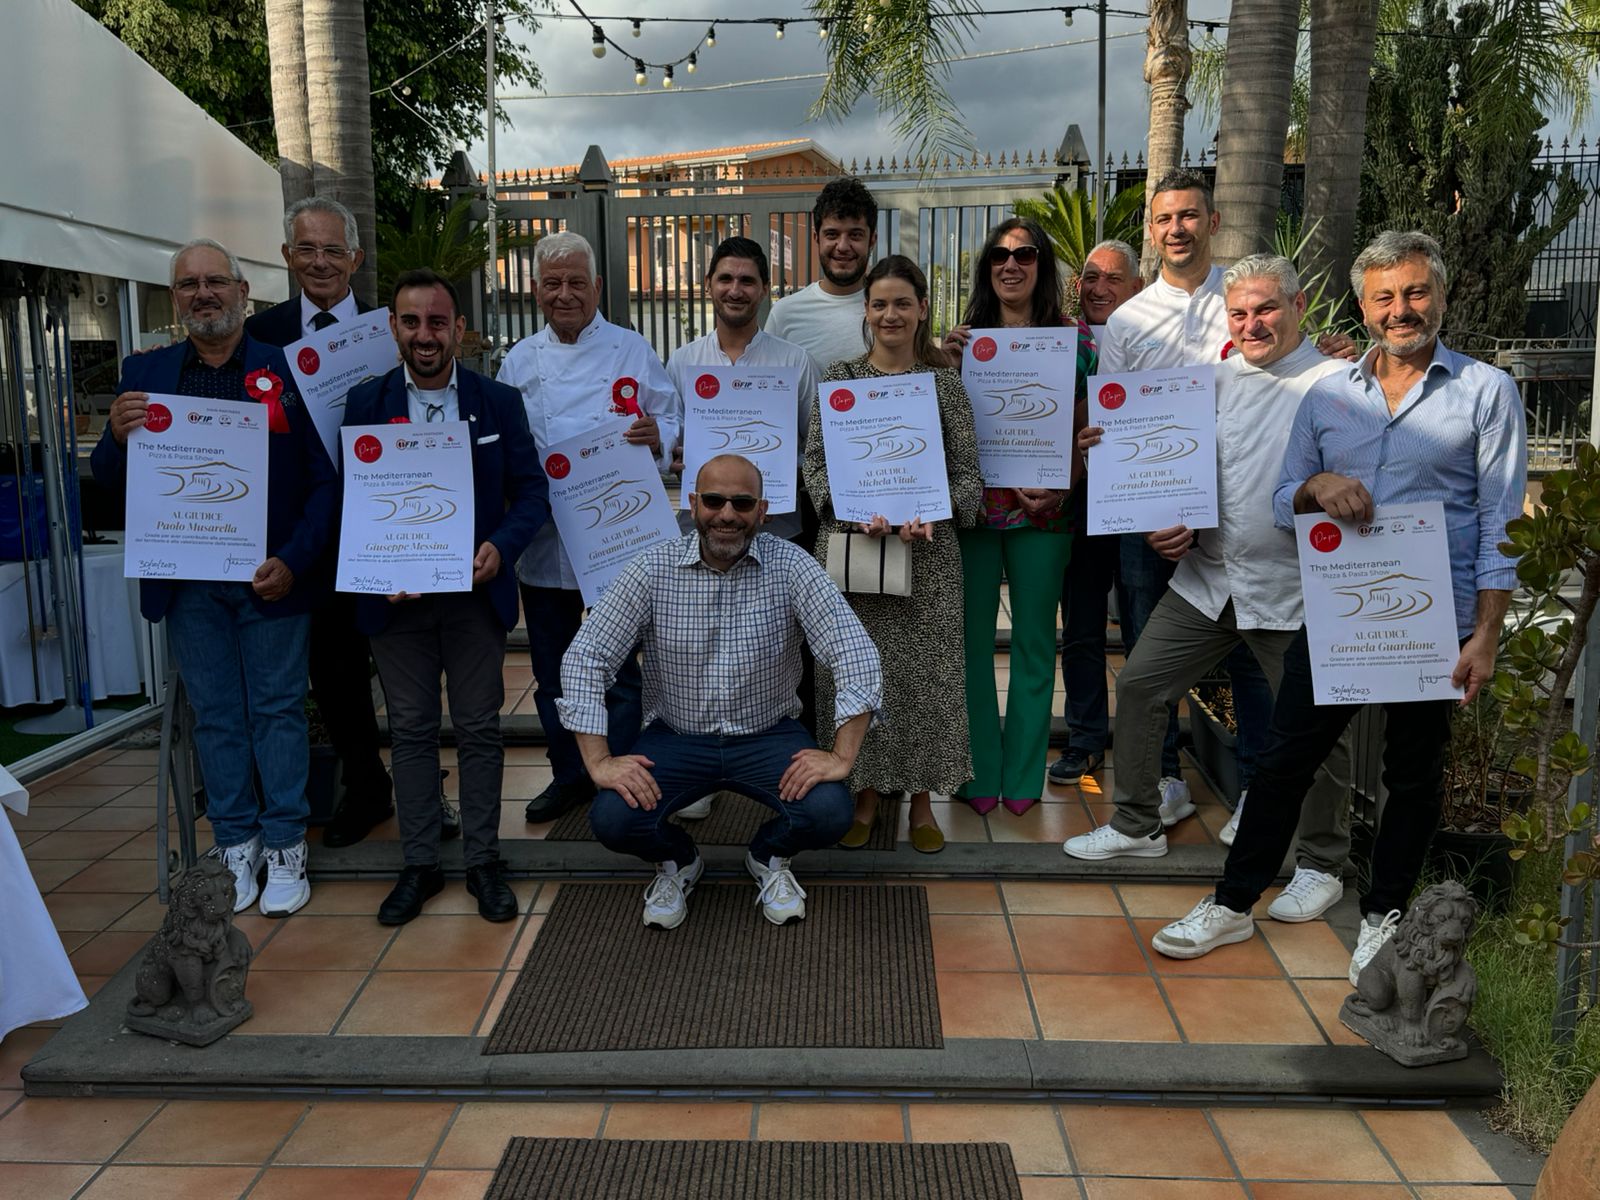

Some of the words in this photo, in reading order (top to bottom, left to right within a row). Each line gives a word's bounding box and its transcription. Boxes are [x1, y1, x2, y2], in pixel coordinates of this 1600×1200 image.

[307, 386, 319, 396] The
[845, 416, 902, 425] Mediterranean
[1114, 414, 1174, 425] Mediterranean
[1011, 438, 1055, 446] Guardione
[137, 442, 154, 450] The
[156, 443, 224, 454] Mediterranean
[875, 468, 907, 476] GIUDICE
[1139, 469, 1174, 478] GIUDICE
[553, 488, 566, 498] The
[567, 470, 619, 493] Mediterranean
[856, 477, 890, 487] Michela
[892, 475, 917, 484] Vitale
[1111, 480, 1148, 490] Corrado
[1150, 475, 1192, 487] Bombaci
[172, 511, 183, 519] AL
[185, 511, 223, 520] GIUDICE
[156, 520, 185, 530] Paolo
[187, 522, 237, 533] Musarella
[1368, 525, 1384, 533] FIP
[601, 536, 609, 544] AL
[611, 525, 640, 541] GIUDICE
[365, 542, 409, 552] Giuseppe
[410, 541, 449, 550] Messina
[588, 540, 624, 561] Giovanni
[1309, 564, 1327, 572] The
[1329, 559, 1400, 570] Mediterranean
[1354, 631, 1365, 640] AL
[1367, 629, 1408, 639] GIUDICE
[1330, 642, 1375, 654] Carmela
[1377, 639, 1436, 652] Guardione
